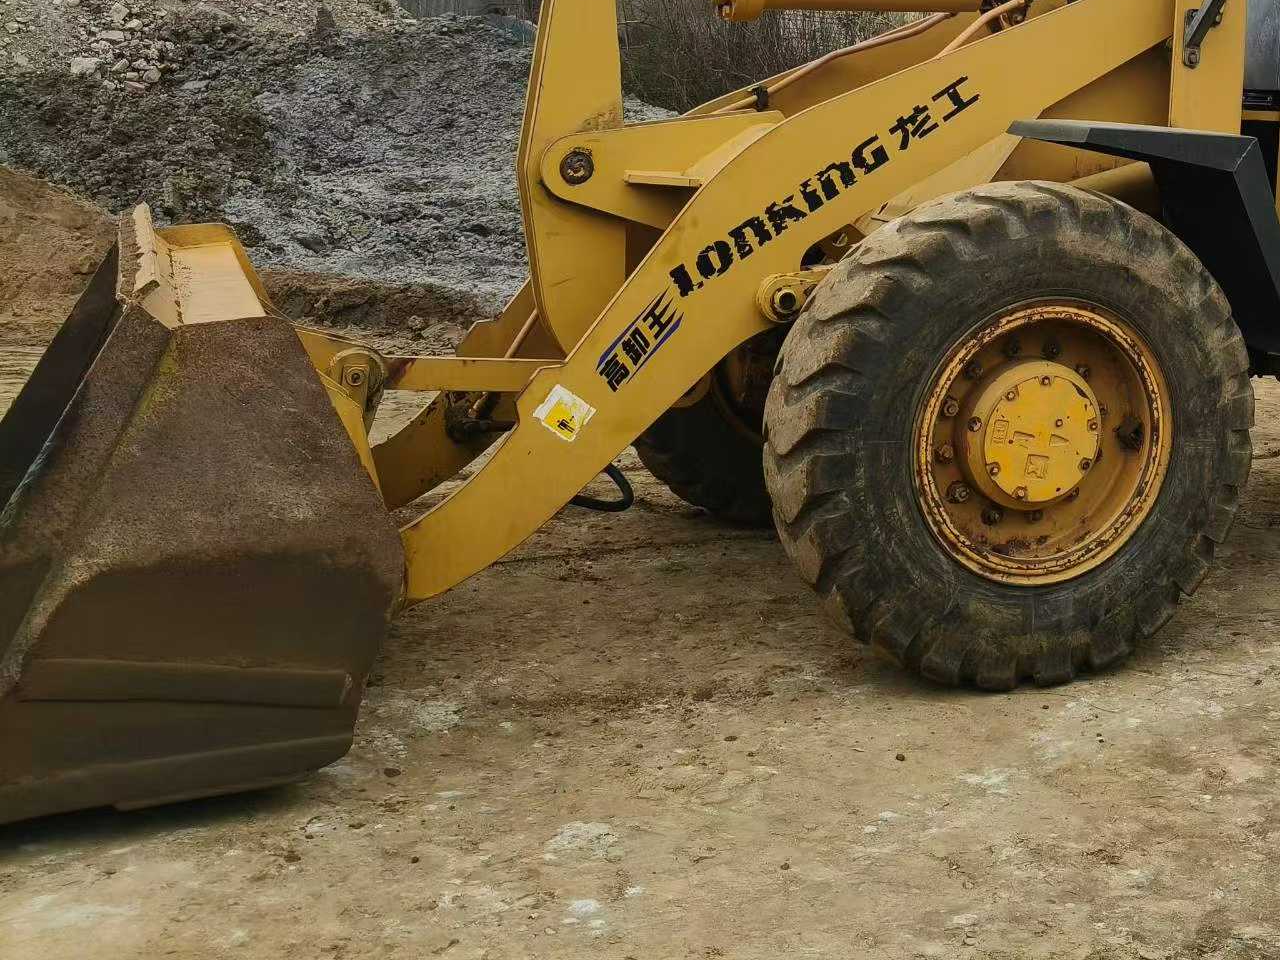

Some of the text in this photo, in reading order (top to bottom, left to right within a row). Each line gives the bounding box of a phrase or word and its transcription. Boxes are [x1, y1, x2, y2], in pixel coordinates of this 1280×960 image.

[888, 75, 982, 151] 龙工
[598, 285, 679, 393] 高卸王
